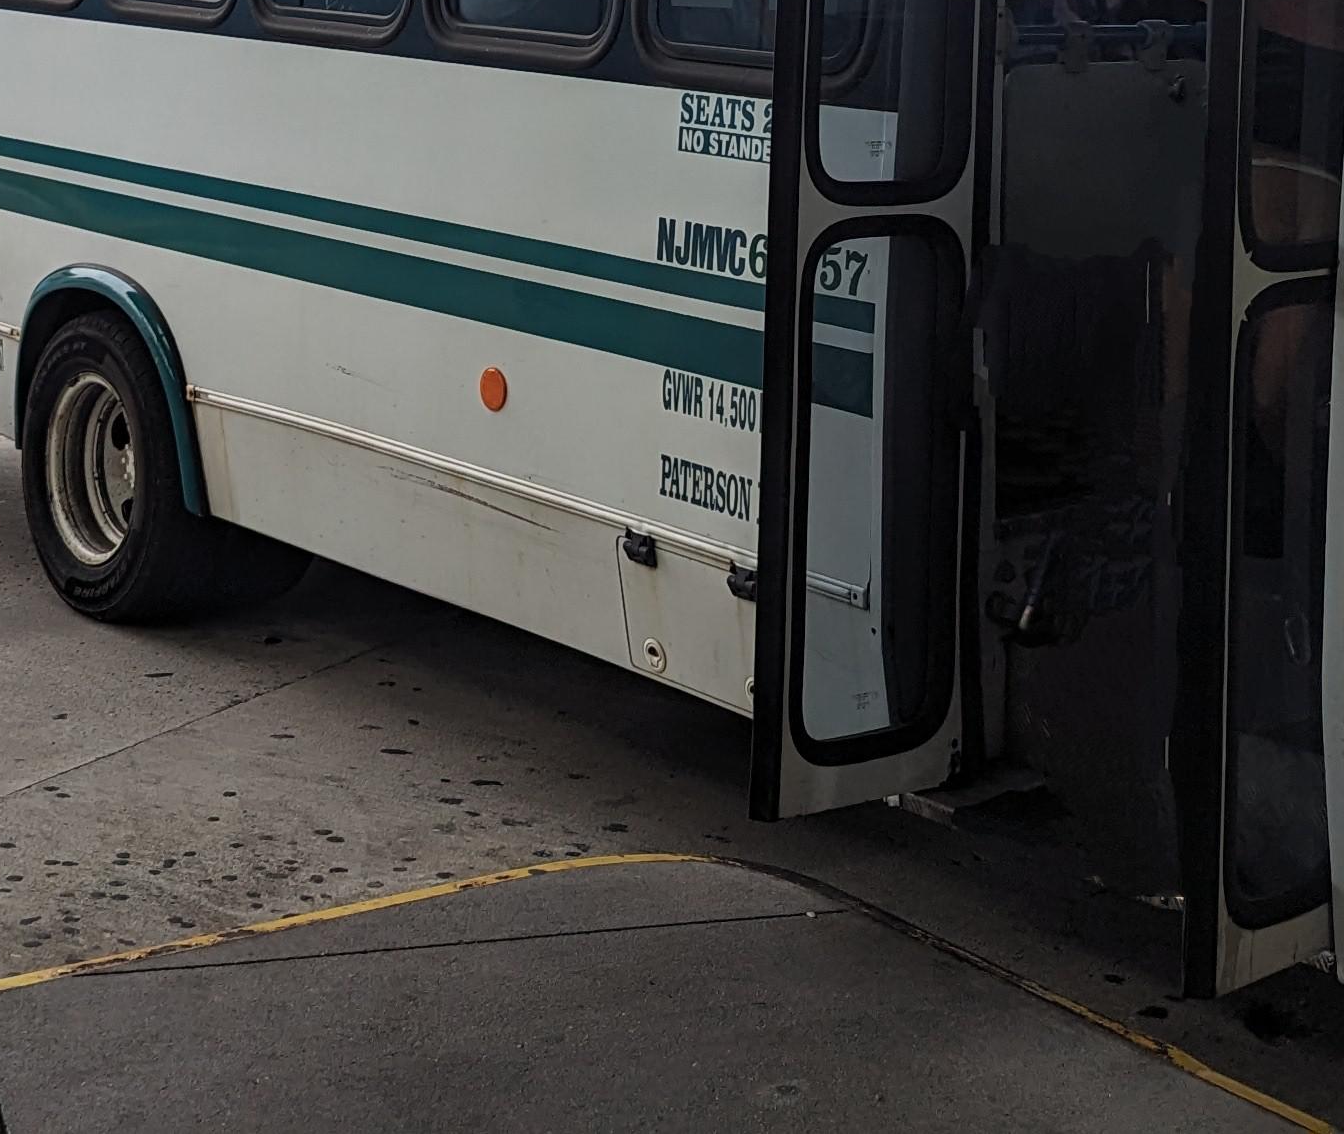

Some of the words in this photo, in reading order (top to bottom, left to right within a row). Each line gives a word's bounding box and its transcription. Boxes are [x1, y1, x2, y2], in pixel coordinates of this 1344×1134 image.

[680, 92, 755, 133] SEATS
[681, 128, 705, 153] NO
[662, 369, 703, 418] GVWR
[708, 381, 756, 432] 14,500
[659, 453, 753, 522] PATERSON
